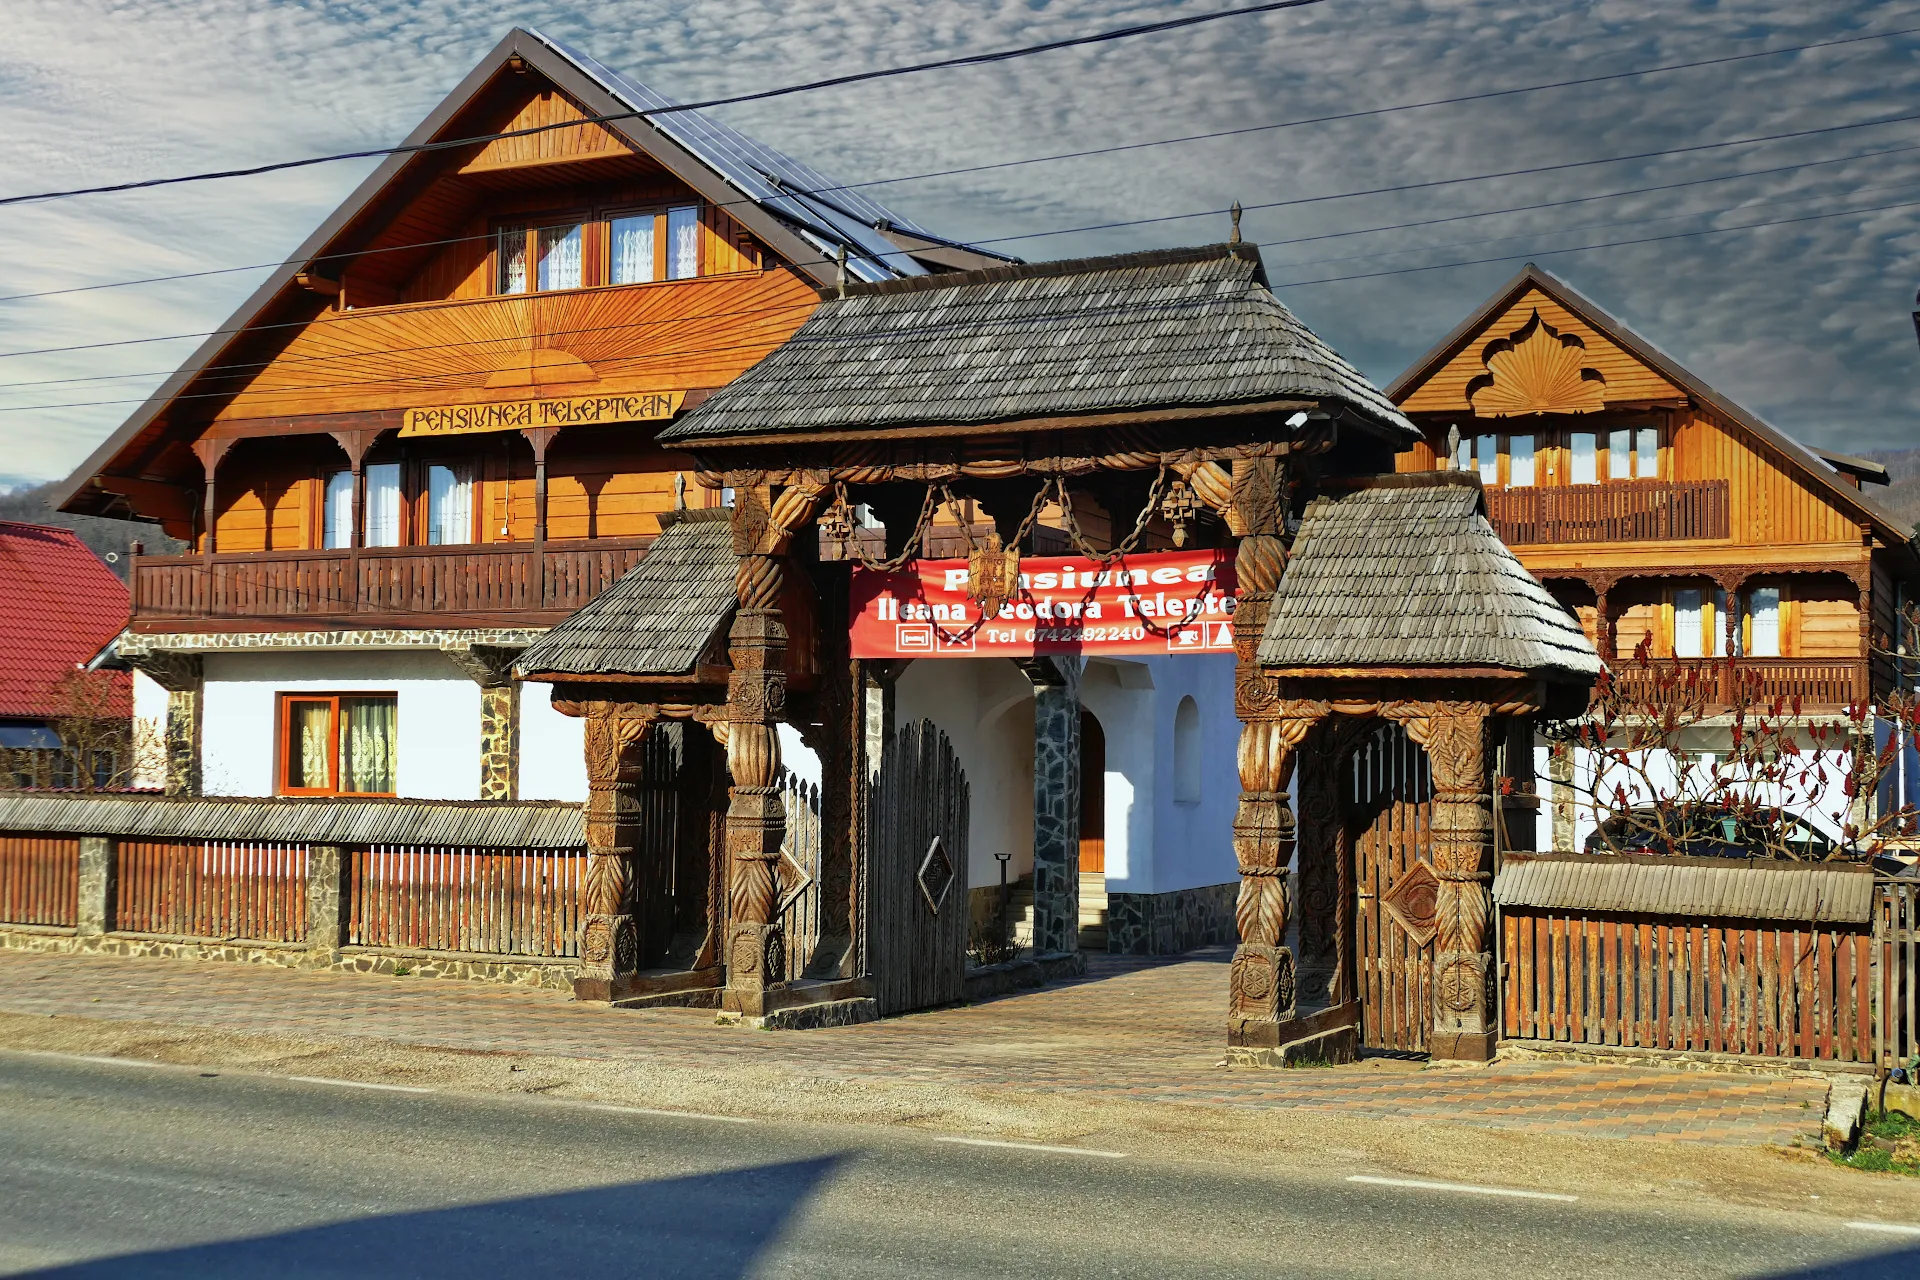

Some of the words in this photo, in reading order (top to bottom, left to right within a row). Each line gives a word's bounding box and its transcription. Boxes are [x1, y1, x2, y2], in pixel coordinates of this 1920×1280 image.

[538, 393, 673, 424] TELEPTEAN
[943, 564, 1215, 592] Psiunea
[877, 597, 967, 621] Ileana
[974, 596, 1102, 620] eodora
[986, 628, 1017, 643] Tel
[1024, 626, 1145, 643] 0742492240
